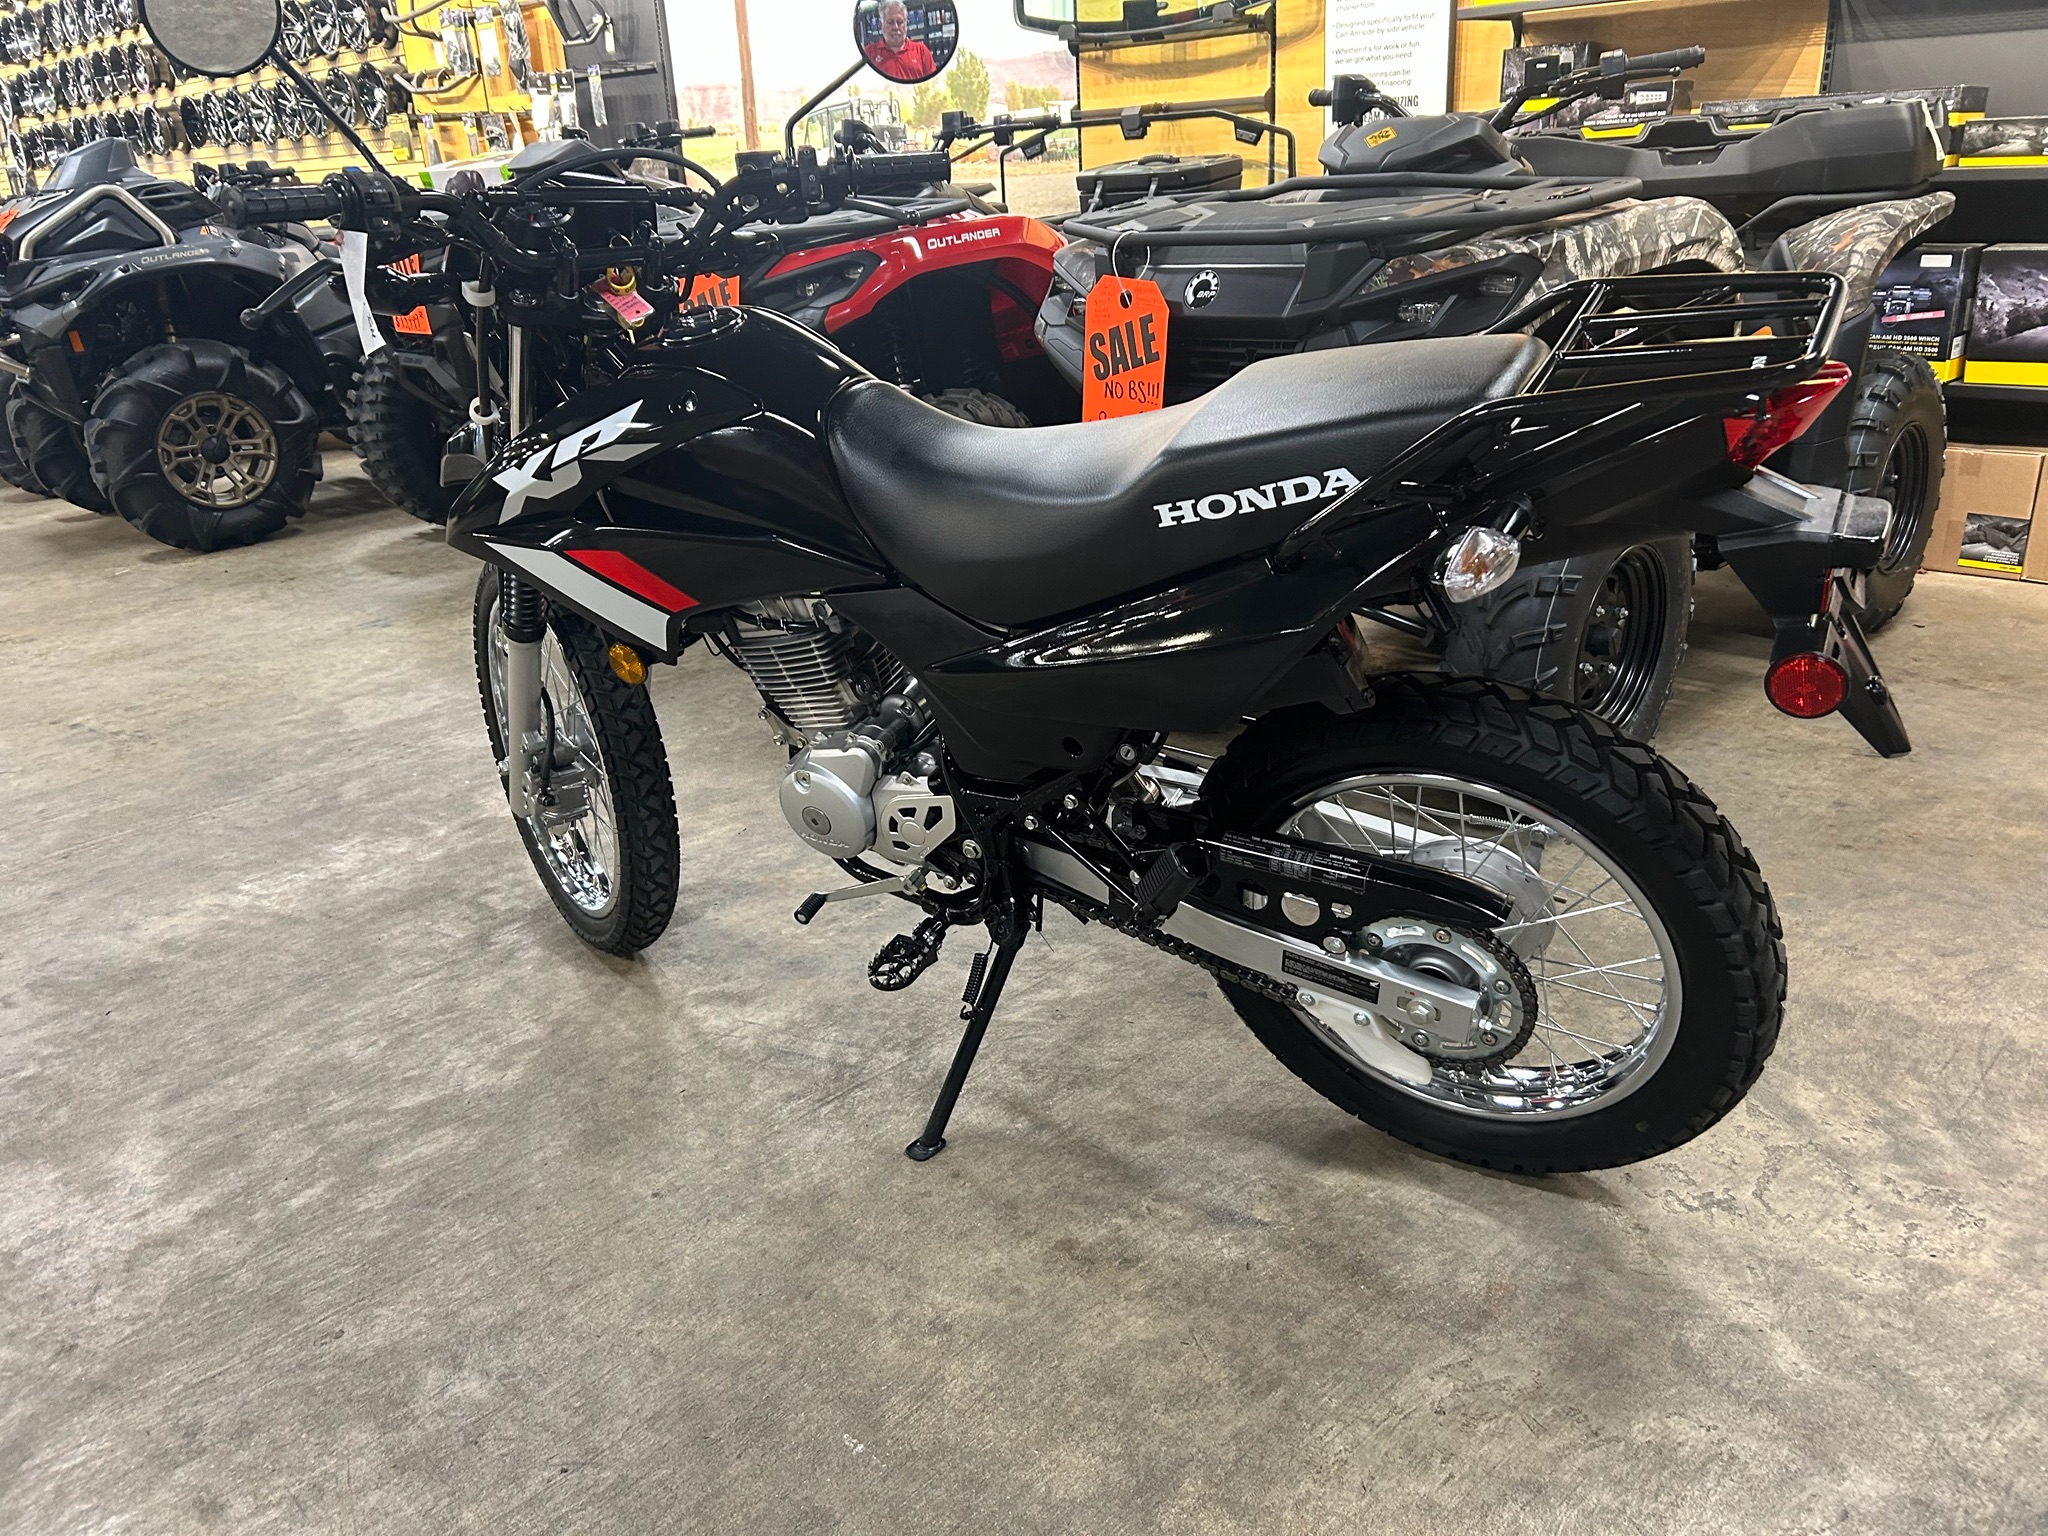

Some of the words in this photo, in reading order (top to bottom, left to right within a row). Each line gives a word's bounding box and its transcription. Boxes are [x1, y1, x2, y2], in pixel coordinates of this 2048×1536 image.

[1336, 20, 1366, 29] Designed
[1367, 15, 1403, 26] specifically
[1420, 12, 1435, 20] your
[1335, 47, 1361, 55] Whether
[1354, 56, 1365, 64] got
[1366, 54, 1381, 62] what
[1382, 53, 1394, 61] you
[927, 228, 1000, 250] OUTLANDER
[141, 248, 210, 264] OUTLANDER
[1196, 290, 1217, 298] BRP
[1089, 313, 1161, 381] SALE
[1104, 380, 1124, 399] NO
[1153, 467, 1361, 528] HONDA
